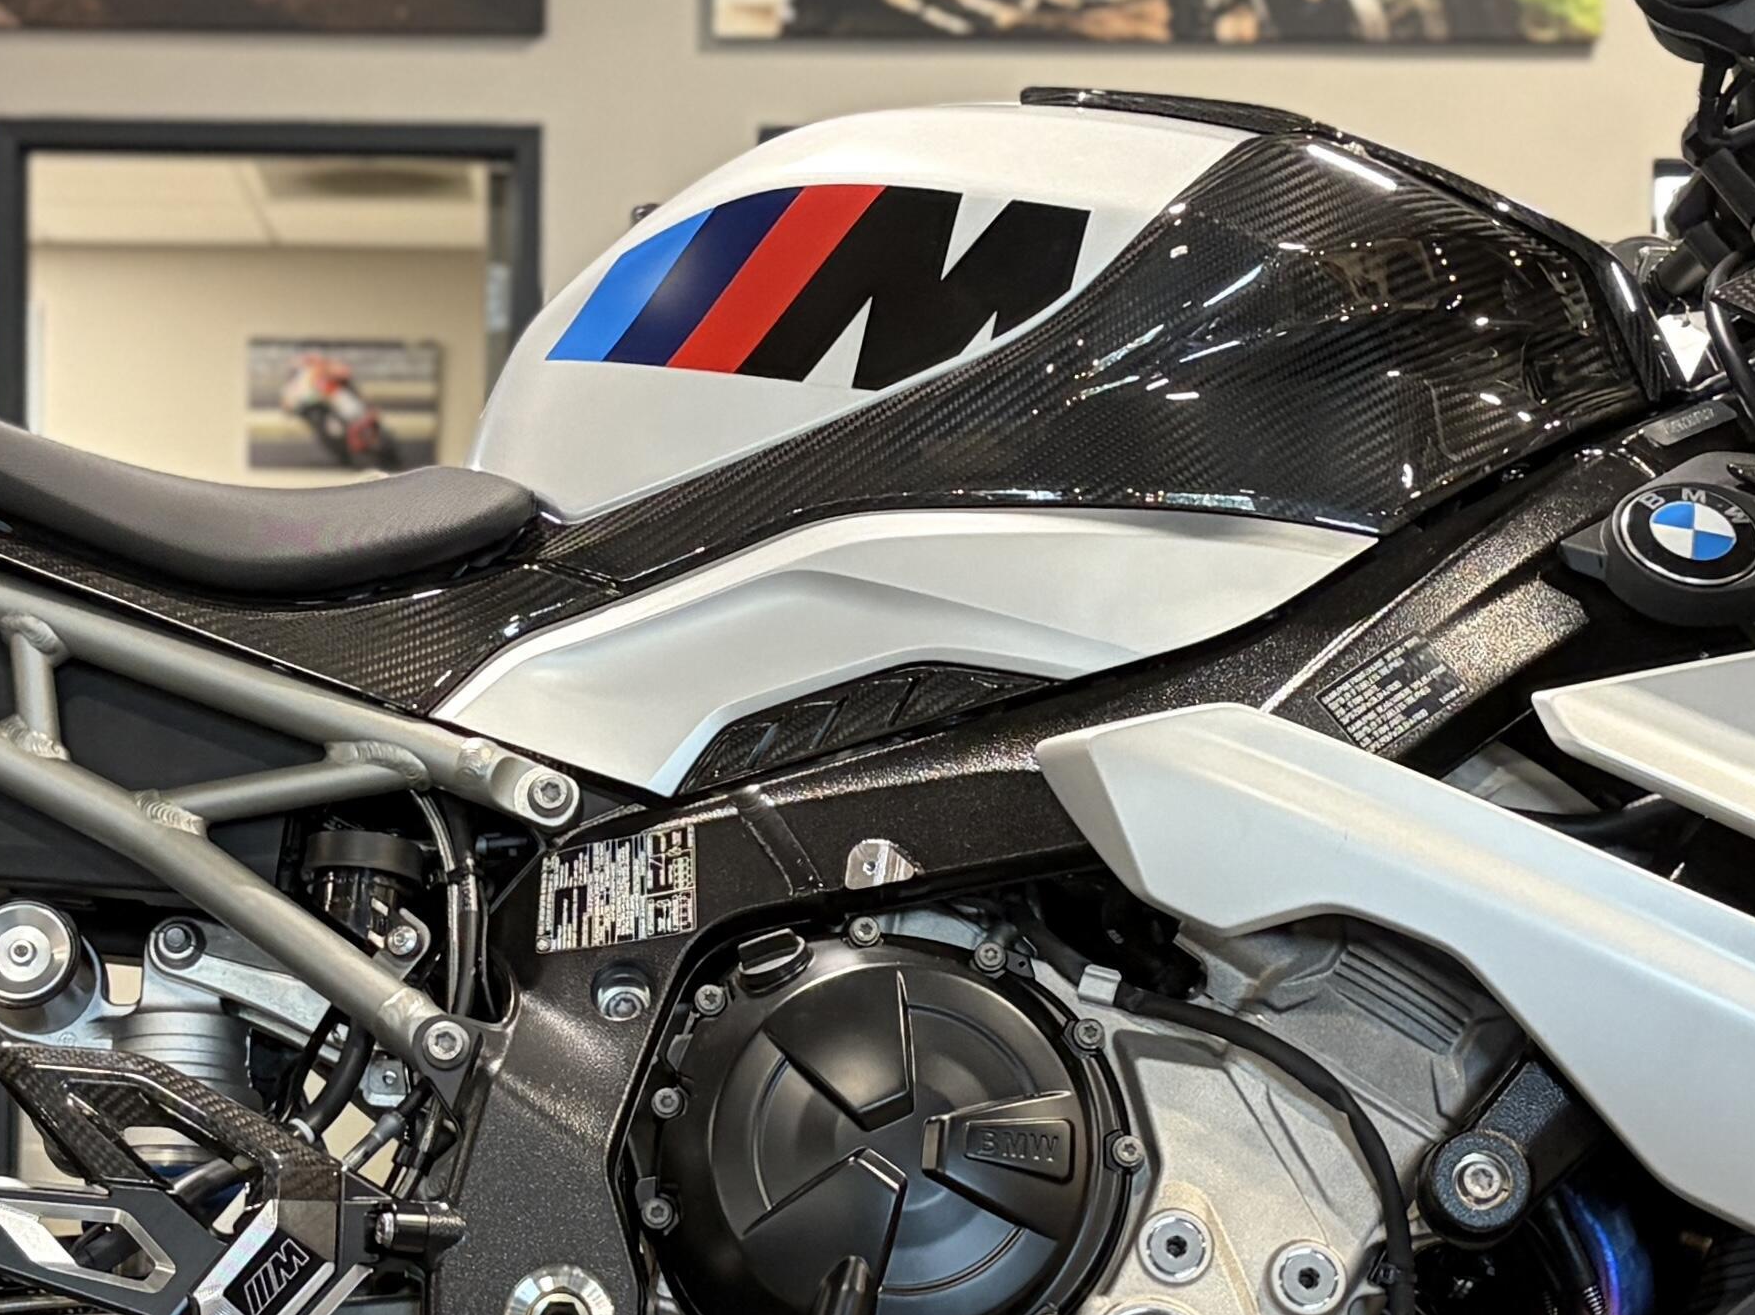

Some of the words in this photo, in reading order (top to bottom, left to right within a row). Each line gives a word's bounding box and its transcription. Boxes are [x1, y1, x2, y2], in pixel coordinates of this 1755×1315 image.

[731, 182, 1092, 392] M
[1637, 487, 1753, 525] BMW
[977, 1127, 1060, 1164] BMW
